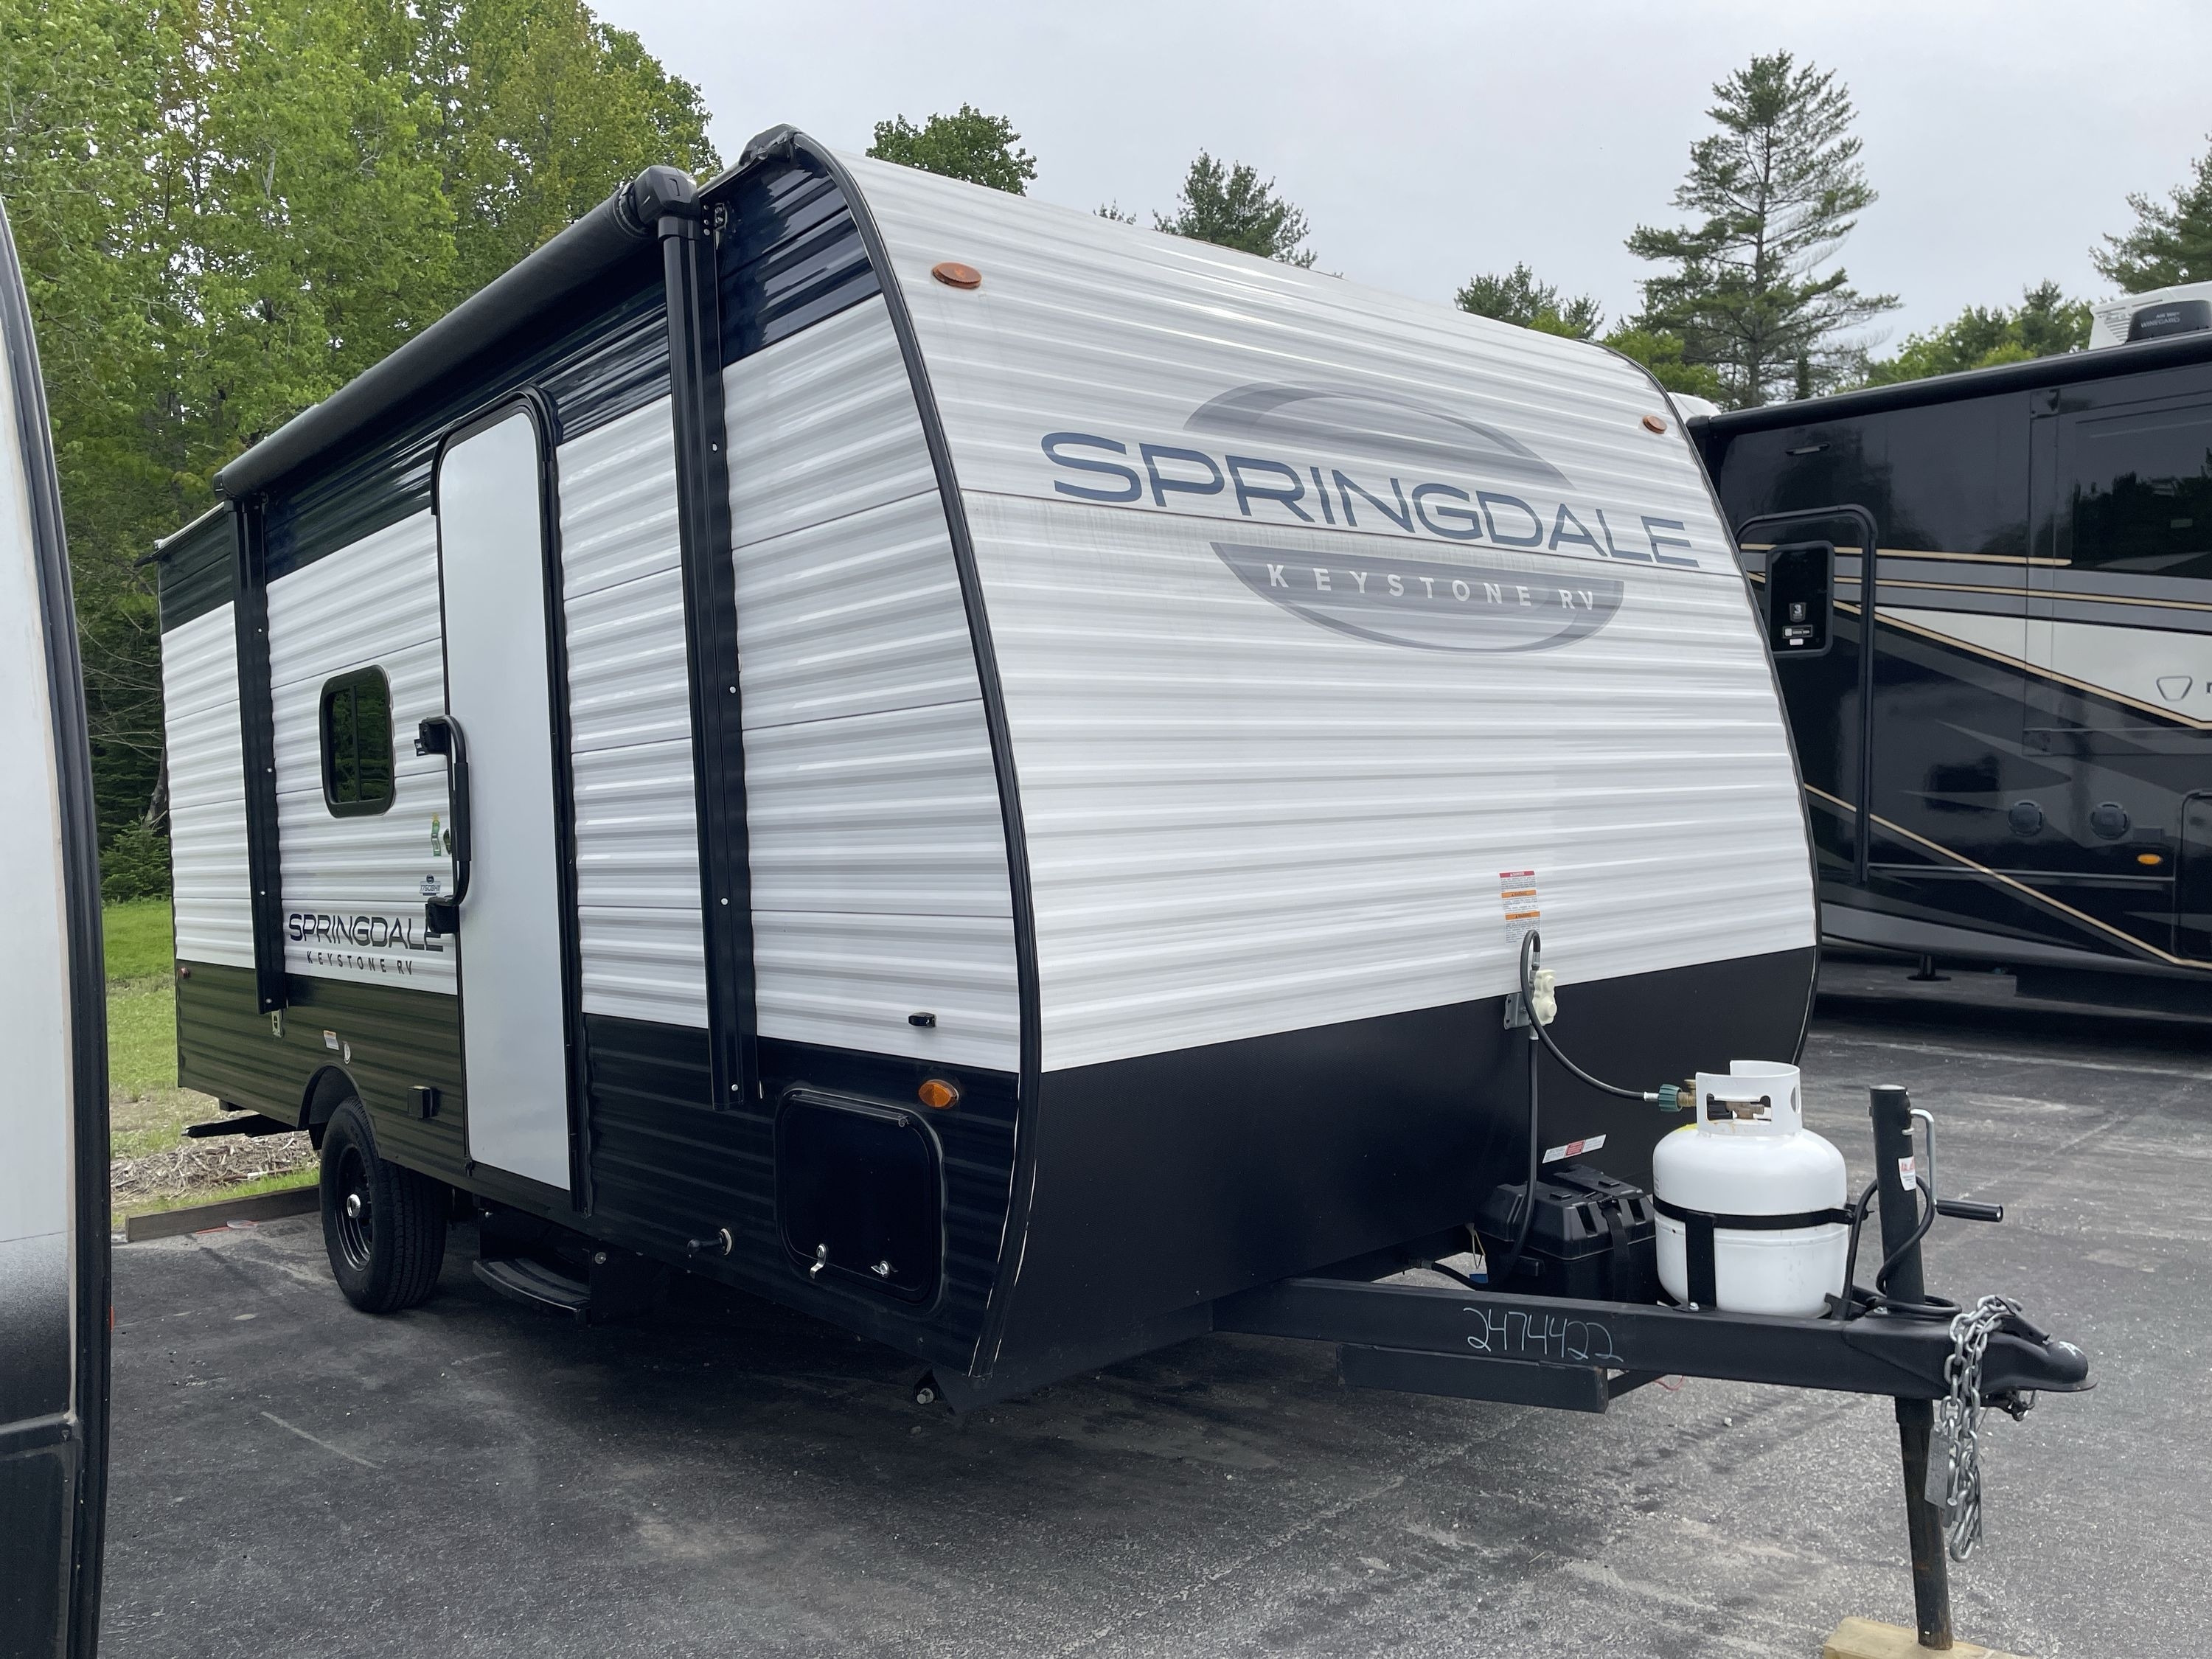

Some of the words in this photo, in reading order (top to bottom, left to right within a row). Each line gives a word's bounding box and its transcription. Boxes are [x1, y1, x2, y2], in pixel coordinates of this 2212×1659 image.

[1041, 432, 1700, 568] SPRINGDALE
[1267, 563, 1532, 607] KEYSTONE
[1559, 589, 1594, 611] RV
[289, 914, 443, 952] SPRINGDALE
[307, 951, 386, 973] KEYSTONE
[397, 960, 413, 975] RV
[1463, 1307, 1624, 1363] 2474422
